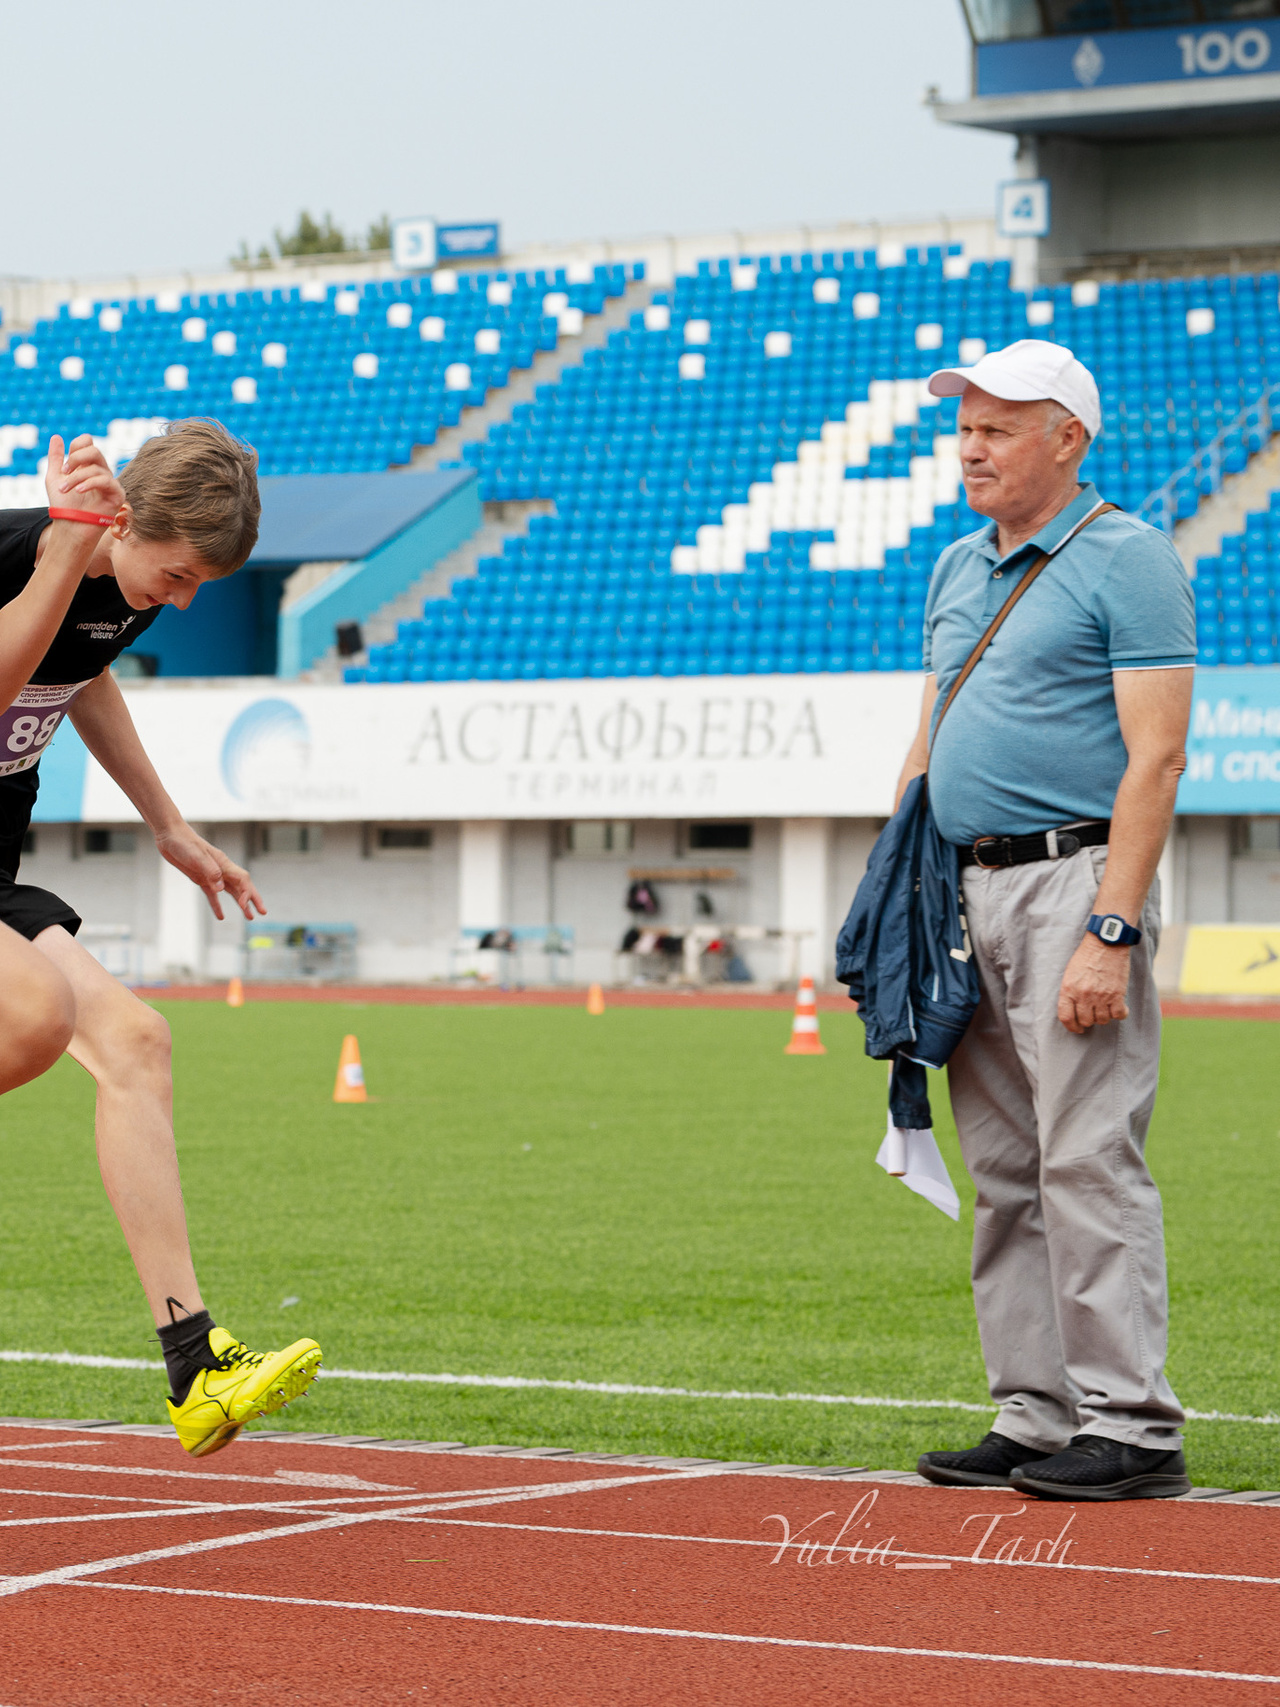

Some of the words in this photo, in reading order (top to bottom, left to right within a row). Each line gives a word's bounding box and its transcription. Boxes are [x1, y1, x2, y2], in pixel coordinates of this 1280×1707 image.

[1177, 28, 1271, 74] 100
[1013, 195, 1032, 219] 4
[77, 621, 118, 631] namdden
[90, 630, 114, 639] leisure
[21, 691, 62, 699] СПОРТИВНЫЕ
[7, 711, 61, 753] 88
[406, 696, 827, 766] АСТАФЬЕВА
[1188, 752, 1215, 782] и
[506, 769, 718, 802] ТЕРМИНАЛ
